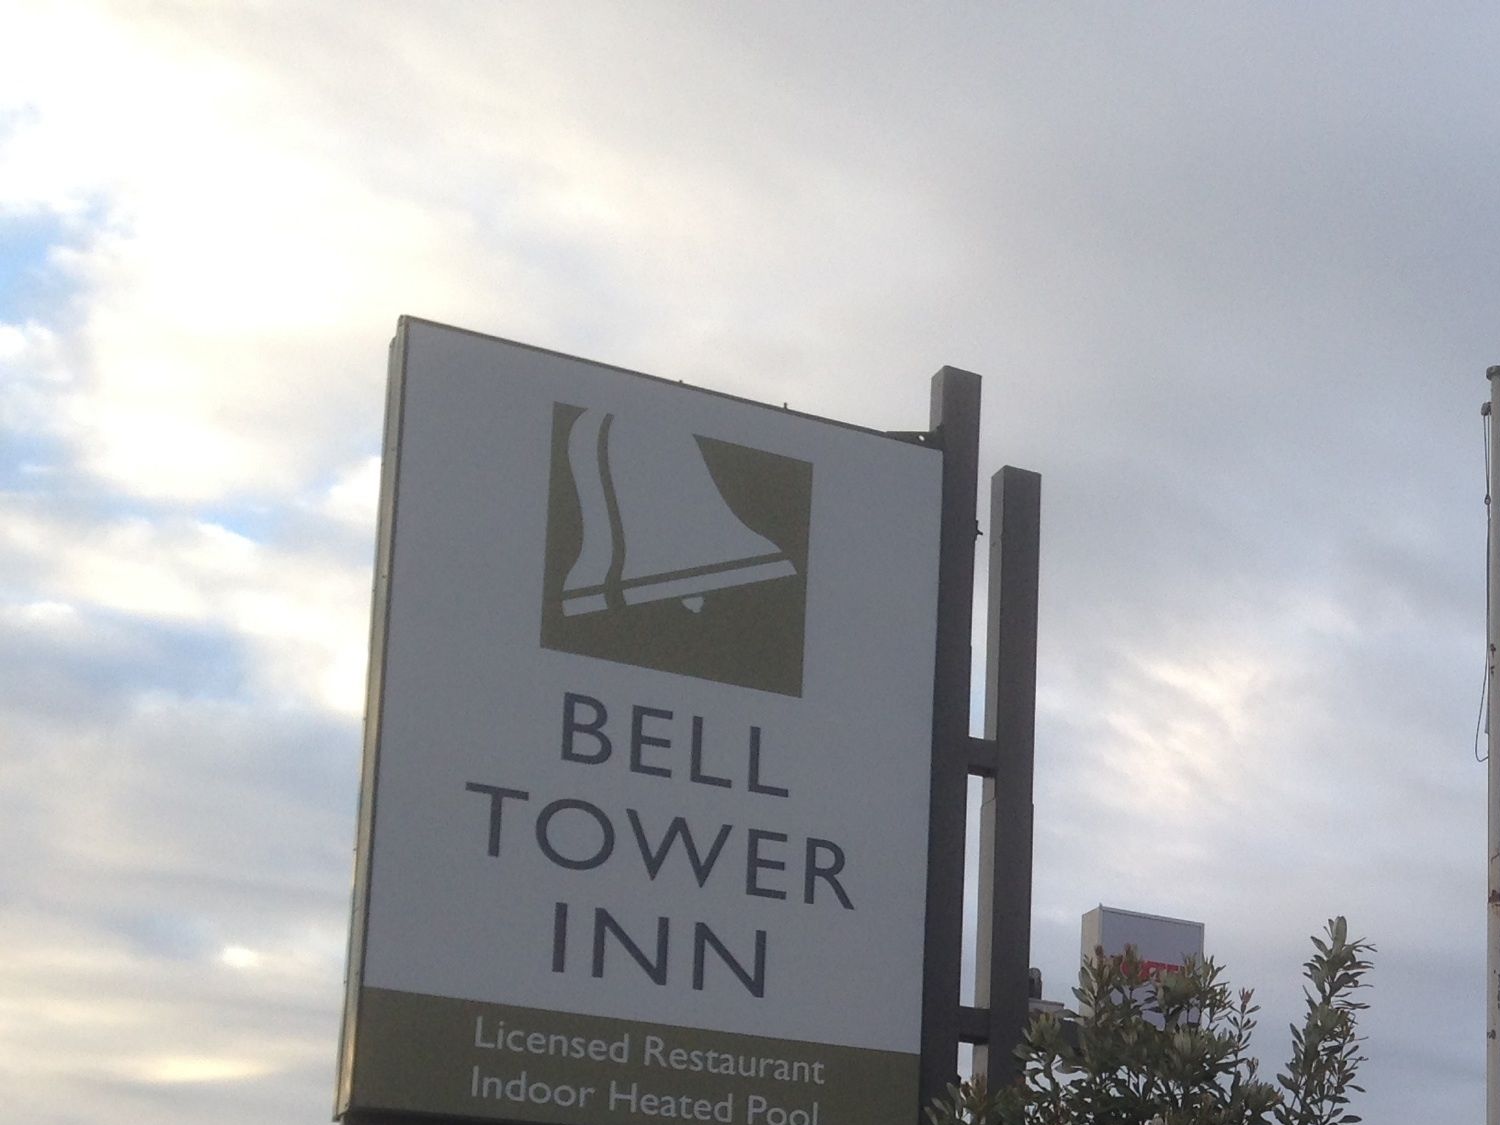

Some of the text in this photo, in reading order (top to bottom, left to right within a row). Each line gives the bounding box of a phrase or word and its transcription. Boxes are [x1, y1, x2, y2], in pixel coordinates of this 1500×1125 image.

[561, 691, 789, 798] BELL
[465, 781, 855, 911] TOWER
[552, 901, 767, 998] INN
[470, 1065, 596, 1108] Indoor
[608, 1079, 733, 1124] Heated
[474, 1015, 825, 1085] Licensed Restaurant
